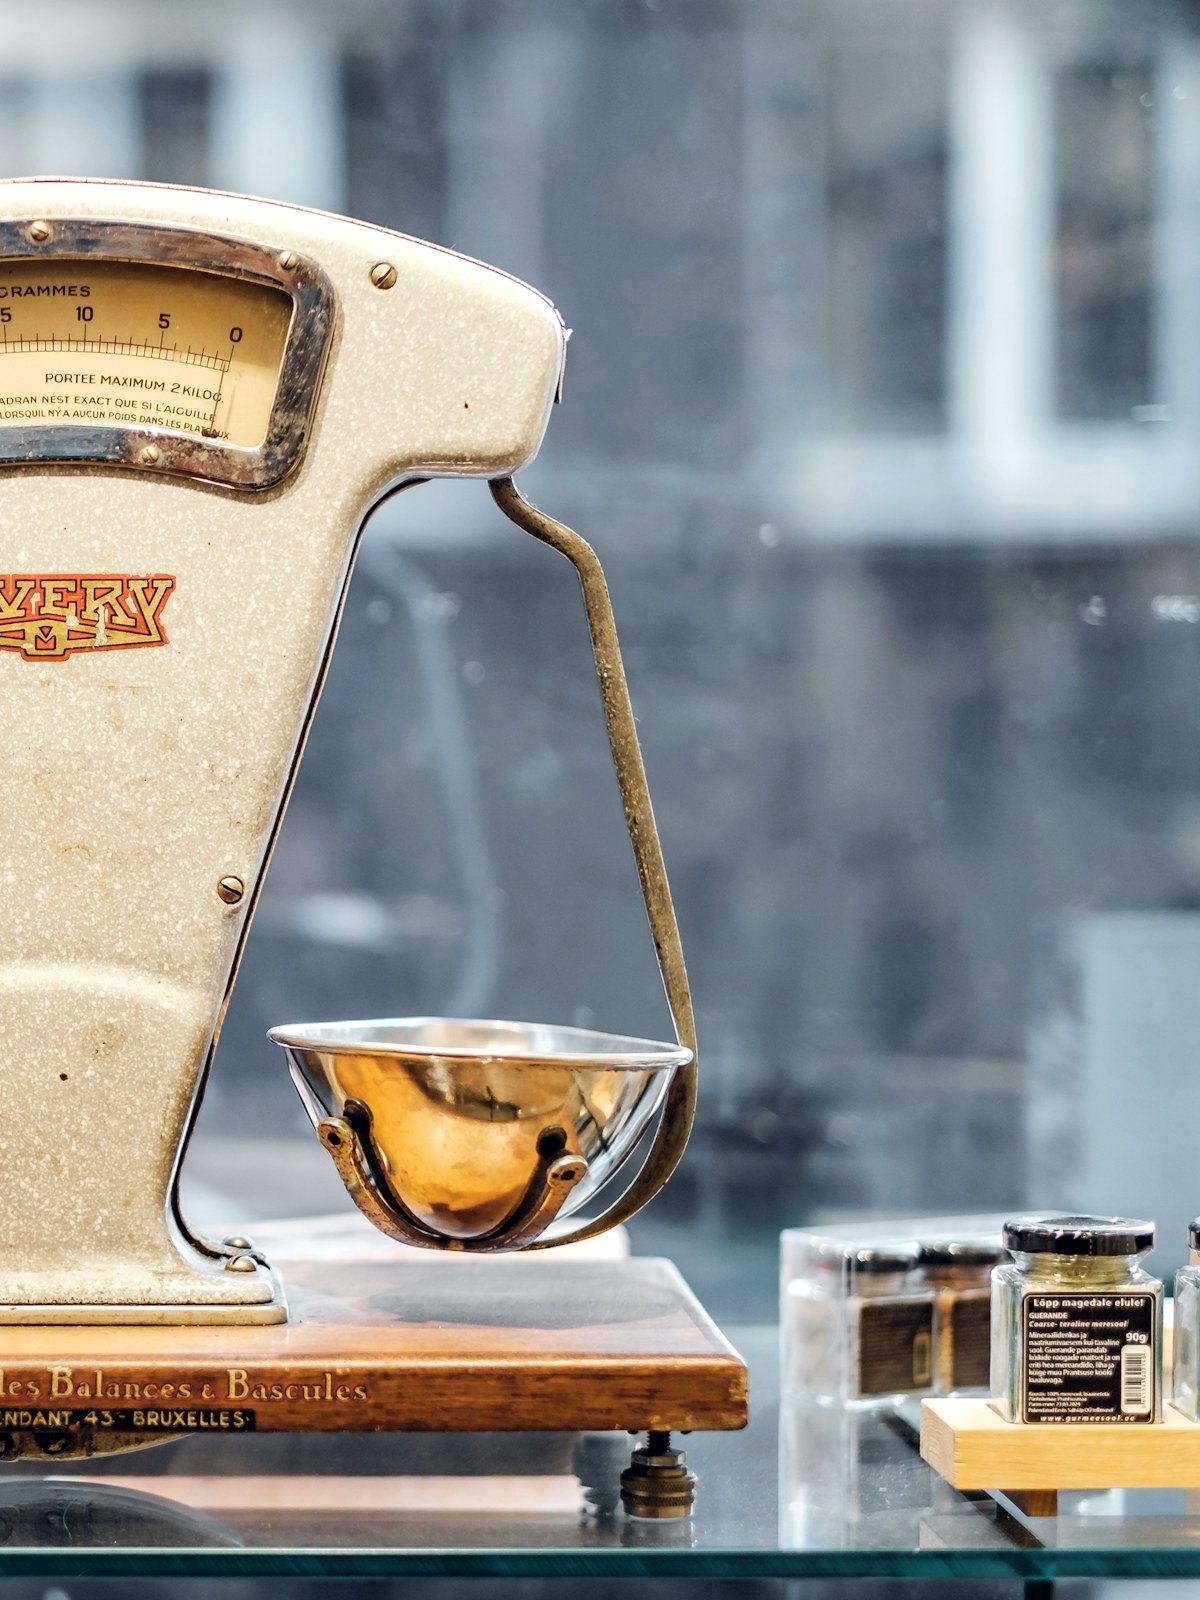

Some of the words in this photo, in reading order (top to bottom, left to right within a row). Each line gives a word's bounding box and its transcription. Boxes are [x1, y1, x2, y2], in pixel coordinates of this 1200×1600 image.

[75, 306, 94, 322] 10
[158, 313, 172, 329] 5
[229, 327, 243, 343] 0
[45, 373, 97, 385] PORTEE
[100, 375, 166, 391] MAXIMUM
[74, 395, 112, 406] EXACT
[114, 398, 138, 408] QUE
[141, 401, 152, 410] SI
[72, 409, 106, 419] AUCUN
[108, 411, 137, 422] POIDS
[139, 415, 164, 426] DANS
[165, 419, 182, 429] LES
[1061, 1298, 1112, 1309] magedale
[1114, 1297, 1145, 1307] elule!
[1028, 1312, 1068, 1320] GUERANDE
[1059, 1320, 1090, 1328] teraline
[1125, 1332, 1147, 1344] 90g
[47, 1366, 192, 1399] Balances
[226, 1368, 368, 1401] Bascules
